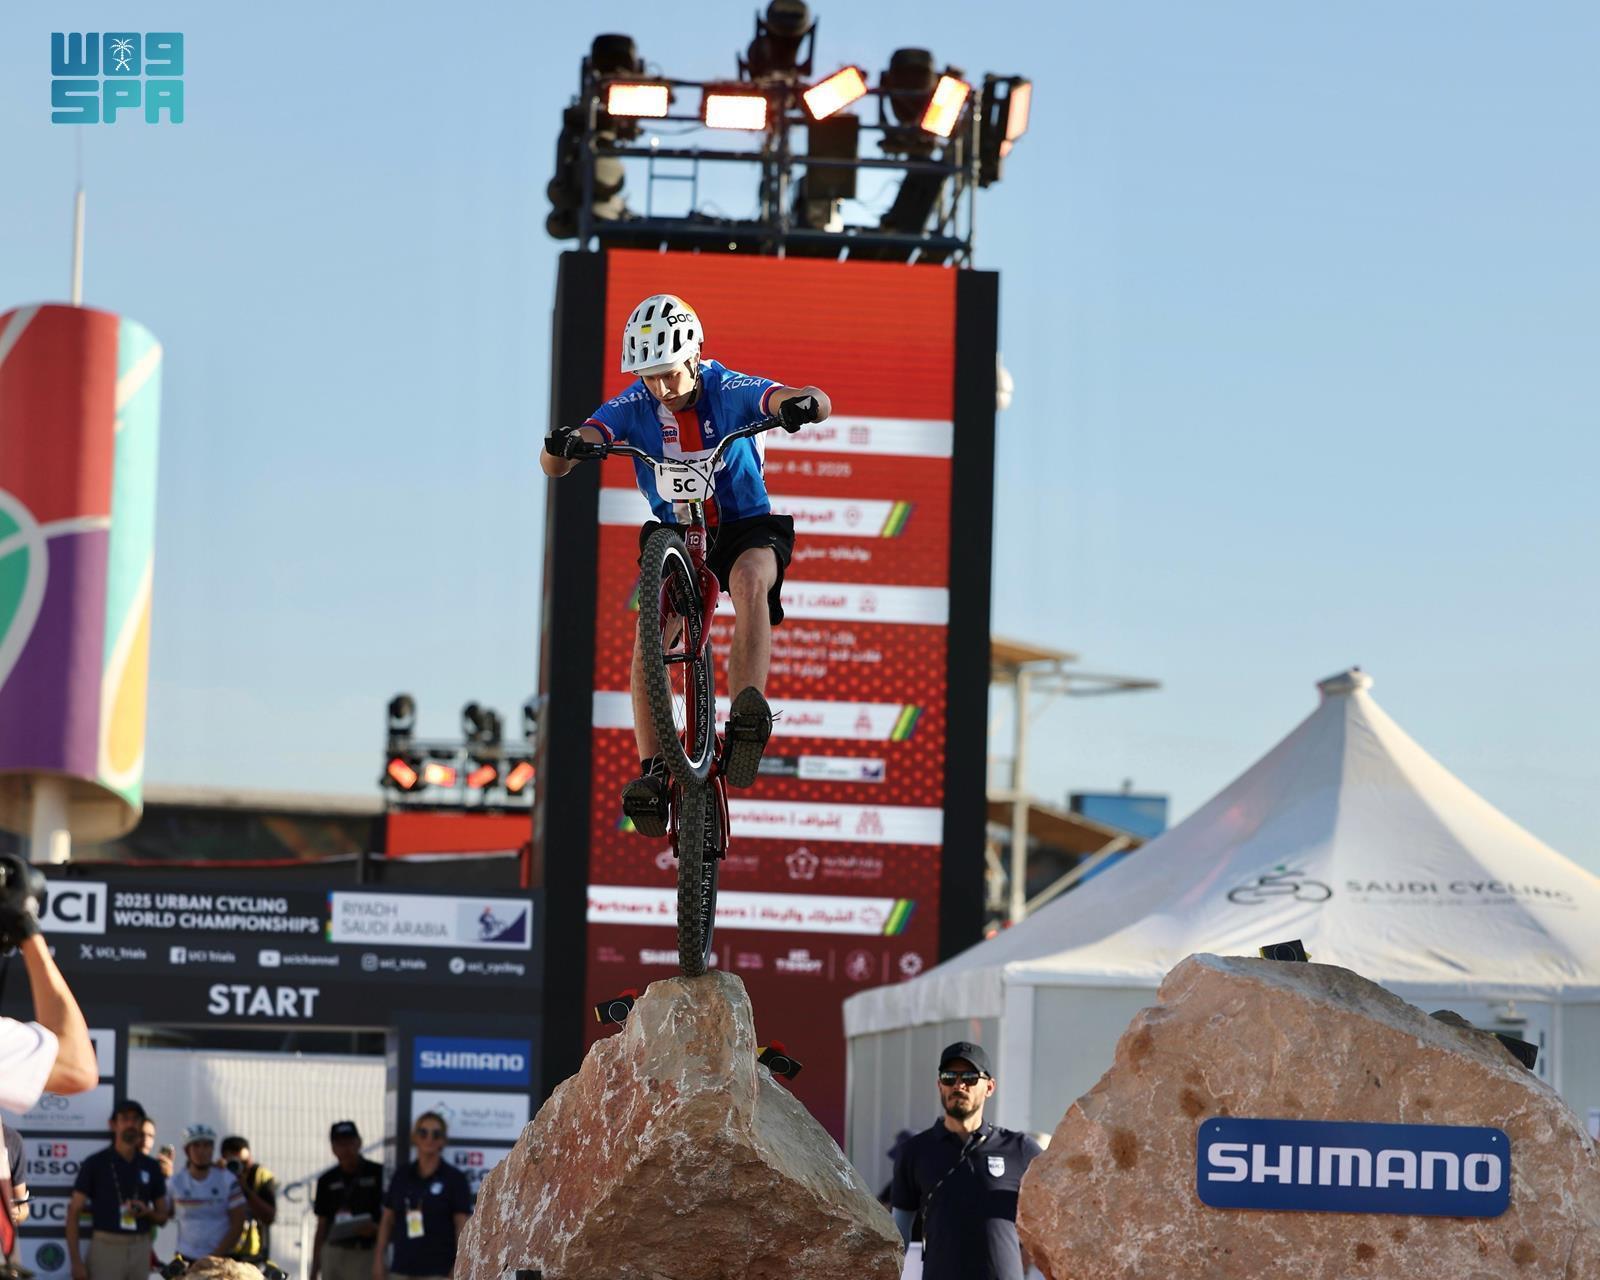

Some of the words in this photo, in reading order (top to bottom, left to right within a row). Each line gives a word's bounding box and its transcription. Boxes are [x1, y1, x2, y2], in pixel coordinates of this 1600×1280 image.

[673, 478, 697, 493] 5C
[1346, 879, 1438, 894] SAUDI
[1448, 880, 1575, 903] CYCLING
[114, 892, 152, 908] 2025
[155, 894, 213, 911] URBAN
[215, 896, 288, 913] CYCLING
[341, 900, 399, 916] RIYADH
[114, 911, 175, 928] WORLD
[179, 914, 320, 933] CHAMPIONSHIPS
[341, 921, 389, 936] SAUDI
[391, 922, 448, 938] ARABIA
[207, 983, 320, 1018] START
[419, 1050, 525, 1073] SHIMANO
[1207, 1142, 1502, 1193] SHIMANO
[30, 1203, 65, 1221] UC
